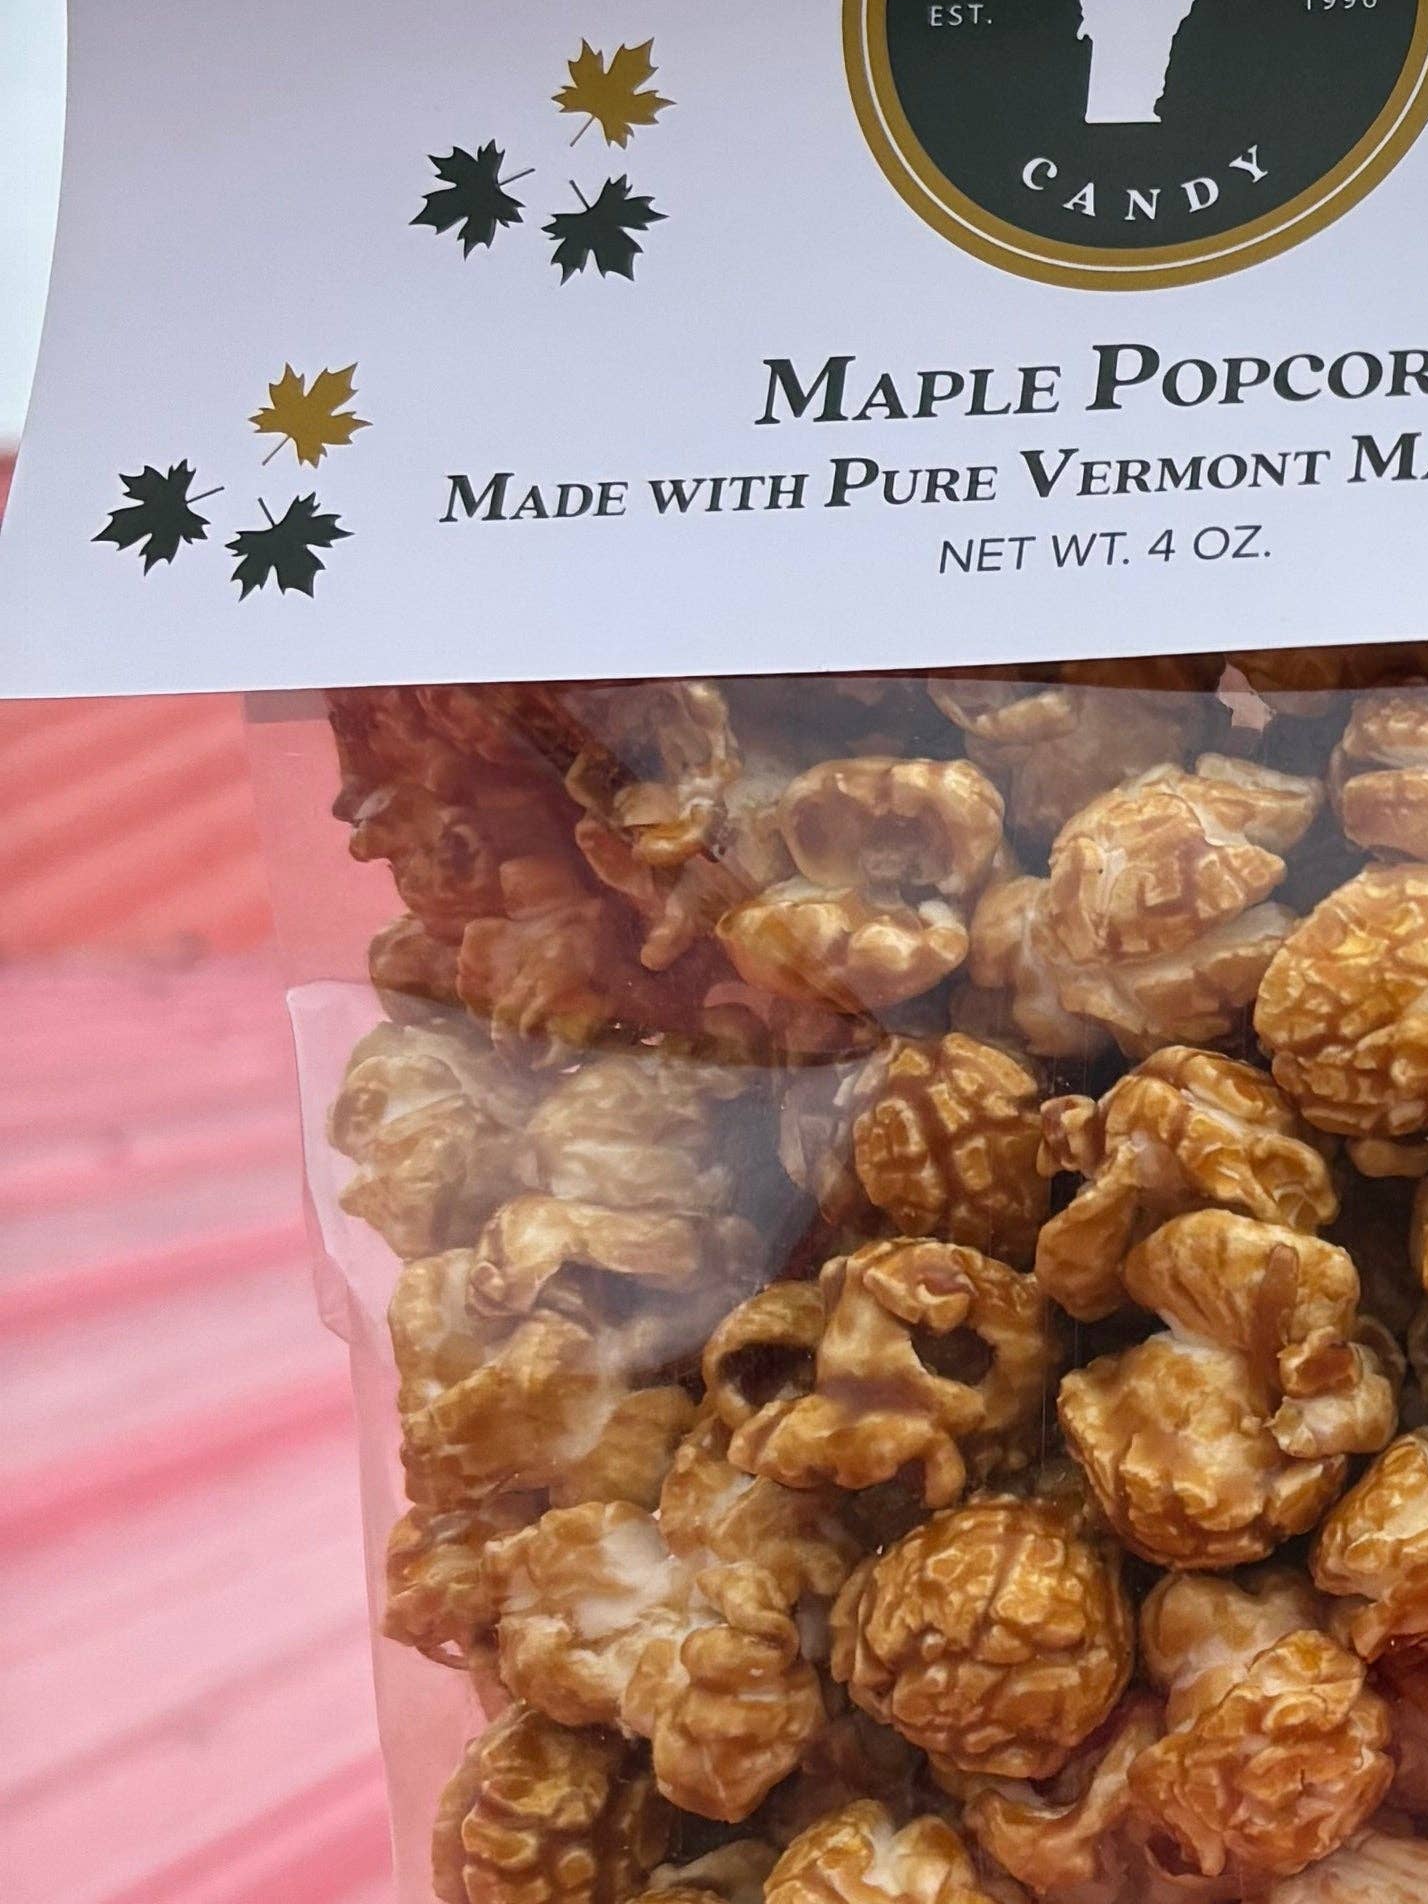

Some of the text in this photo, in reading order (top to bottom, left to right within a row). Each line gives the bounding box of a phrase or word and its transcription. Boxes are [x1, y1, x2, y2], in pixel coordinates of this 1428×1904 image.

[929, 2, 993, 28] EST.
[1021, 143, 1270, 222] CANDY
[754, 354, 1062, 426] MAPLE
[437, 472, 630, 523] MADE
[647, 472, 811, 514] WITH
[822, 456, 999, 508] PURE
[1019, 448, 1332, 498] VERMONT
[938, 524, 1274, 574] NET WT. 4 OZ.
